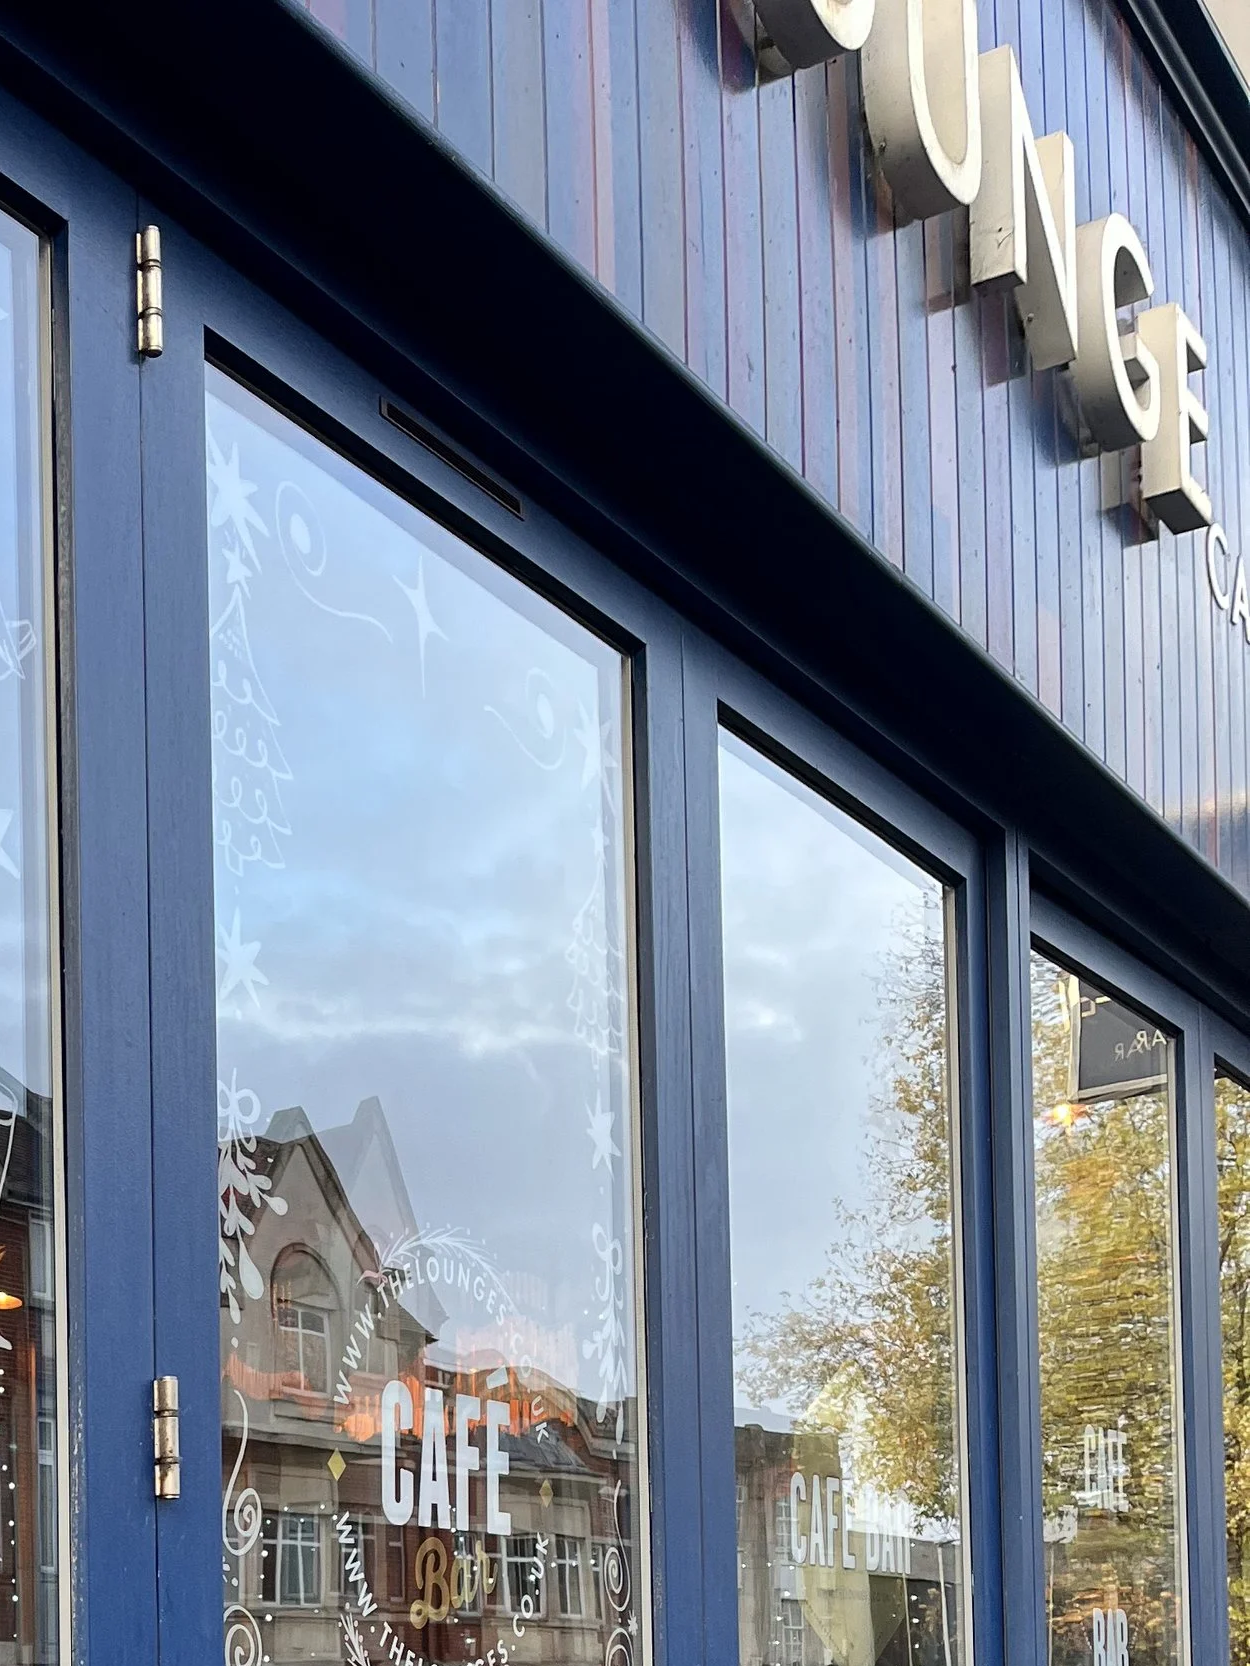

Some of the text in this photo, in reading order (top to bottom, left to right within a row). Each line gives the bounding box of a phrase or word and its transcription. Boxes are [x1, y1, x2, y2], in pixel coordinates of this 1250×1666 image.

[753, 0, 1213, 533] UNGE
[381, 1365, 512, 1536] CAFÉ
[409, 1536, 498, 1629] Bar
